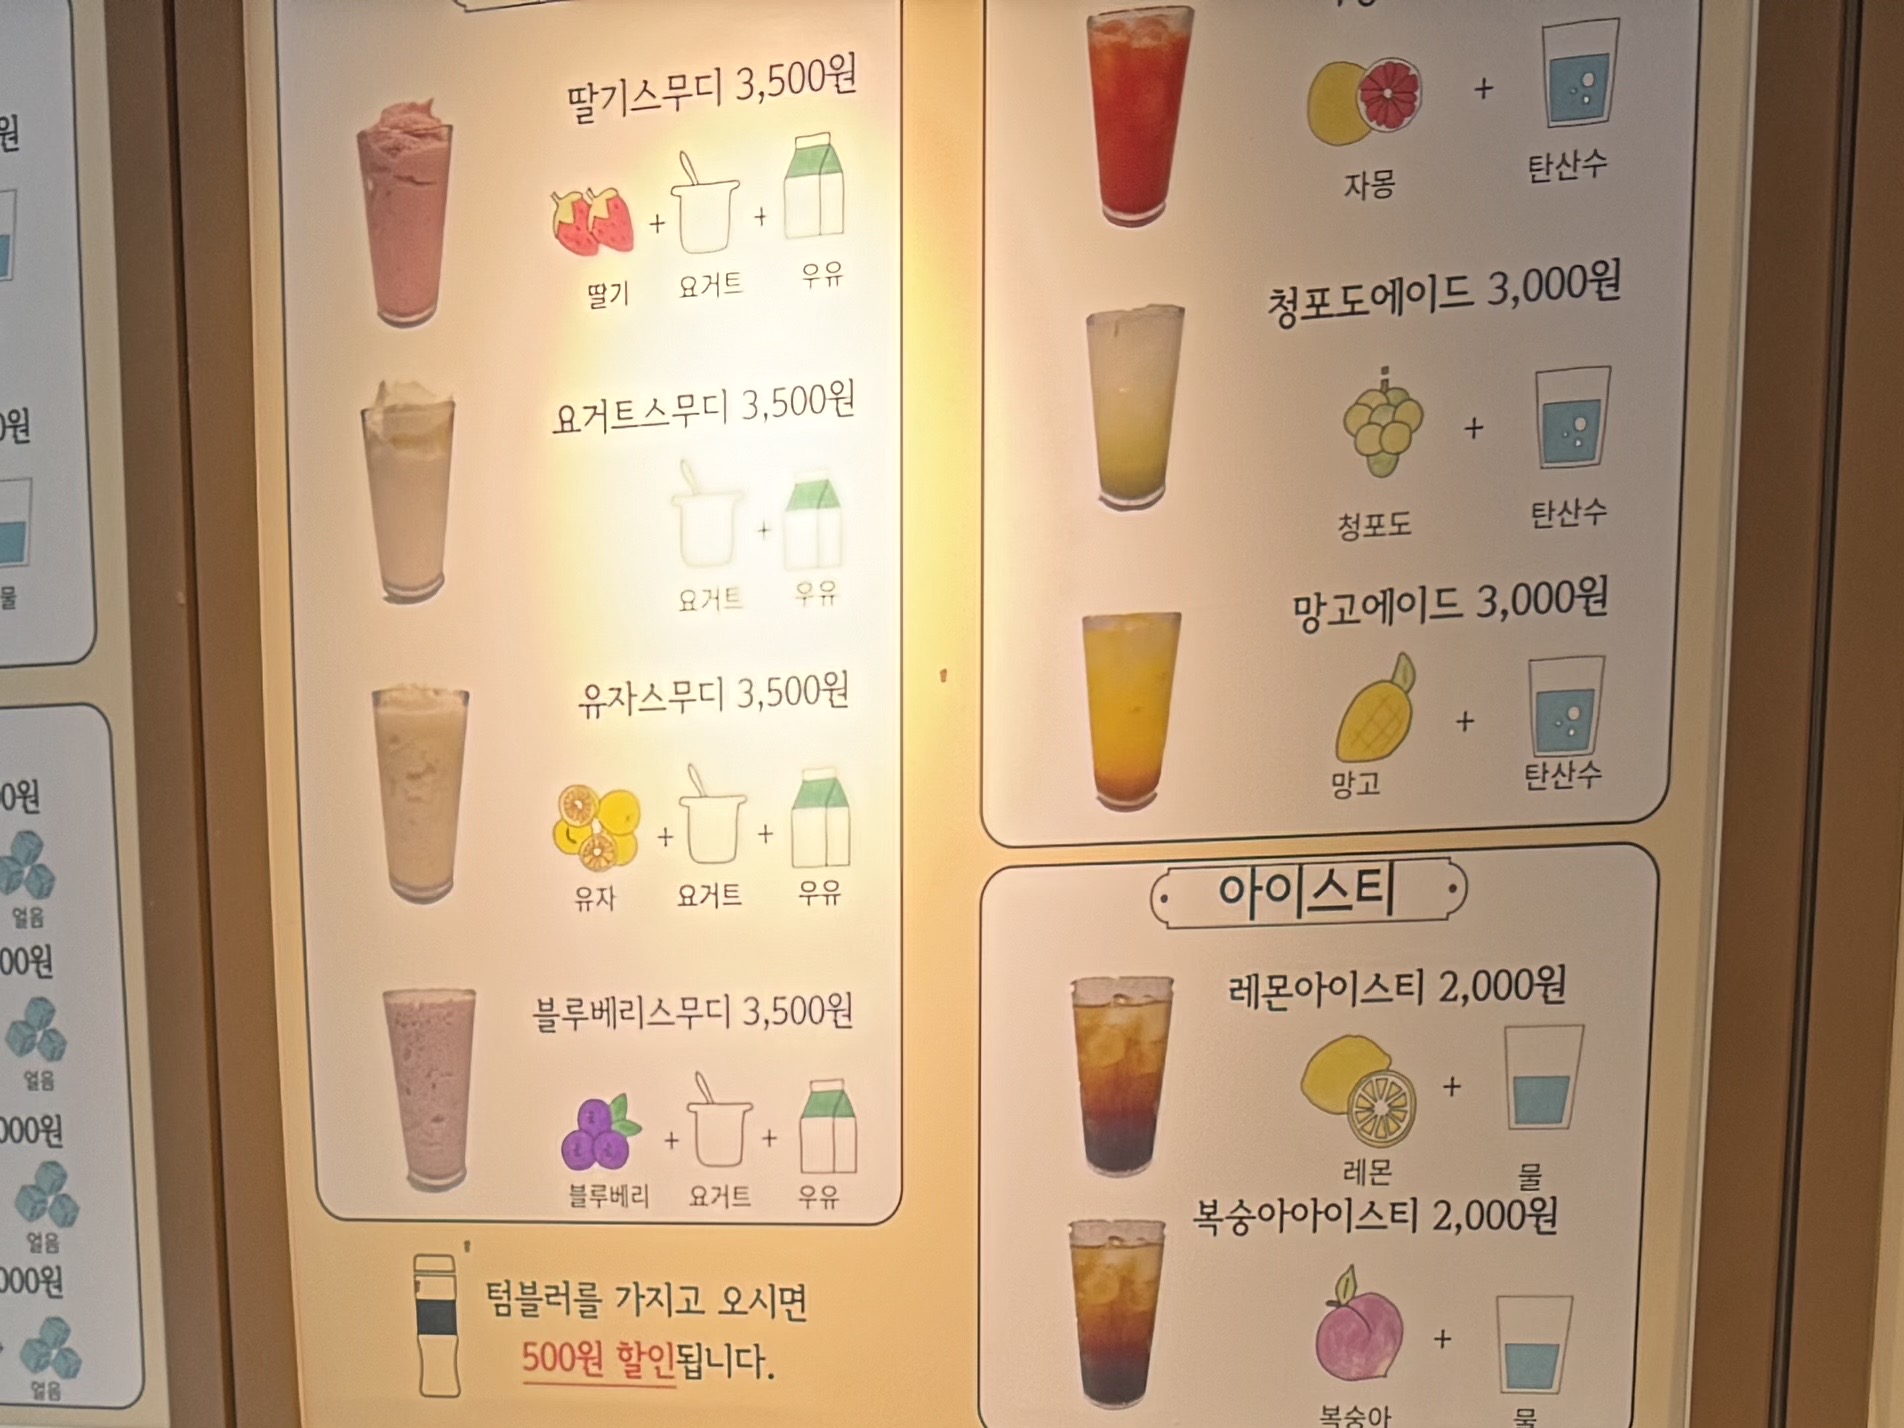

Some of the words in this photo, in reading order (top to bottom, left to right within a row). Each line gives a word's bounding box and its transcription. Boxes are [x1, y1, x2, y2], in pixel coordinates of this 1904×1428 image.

[568, 67, 721, 125] 딸기스무디
[737, 51, 856, 104] 3,500원
[1345, 170, 1395, 201] 자몽
[1529, 149, 1607, 184] 탄산수
[588, 281, 628, 310] 딸기
[681, 272, 742, 298] 요거트
[803, 261, 842, 288] 우유
[1269, 274, 1474, 330] 청포도에이드
[1488, 257, 1620, 309] 3,000원
[552, 389, 726, 434] 요거트스무디
[743, 378, 854, 421] 3,500원
[1339, 511, 1412, 542] 청포도
[1532, 498, 1607, 529] 탄산수
[679, 588, 742, 612] 요거트
[796, 580, 836, 606] 우유
[1294, 585, 1463, 635] 망고에이드
[1477, 574, 1607, 622] 3,000원
[578, 676, 723, 719] 유자스무디
[738, 670, 848, 711] 3,500원
[1332, 771, 1380, 800] 망고
[1526, 760, 1602, 791] 탄산수
[575, 885, 615, 912] 유자
[678, 883, 742, 909] 요거트
[799, 880, 841, 906] 우유
[1219, 860, 1395, 921] 아이스티
[12, 907, 43, 929] 얼음
[1229, 968, 1423, 1011] 레몬아이스티
[1440, 964, 1565, 1007] 2,000원
[533, 994, 729, 1033] 블루베리스무디
[744, 992, 852, 1030] 3,500원
[24, 1070, 54, 1091] 얼음
[1344, 1158, 1392, 1186] 레몬
[1519, 1164, 1542, 1191] 물
[570, 1184, 648, 1209] 블루베리
[689, 1185, 751, 1209] 요거트
[798, 1185, 839, 1210] 우유
[1193, 1197, 1417, 1237] 복숭아아이스티
[1433, 1196, 1557, 1235] 2,000원
[486, 1279, 602, 1319] 텀블러를
[616, 1281, 705, 1318] 가지고
[718, 1283, 806, 1322] 오시면
[523, 1340, 603, 1378] 500원
[617, 1341, 774, 1380] 할인됩니다.
